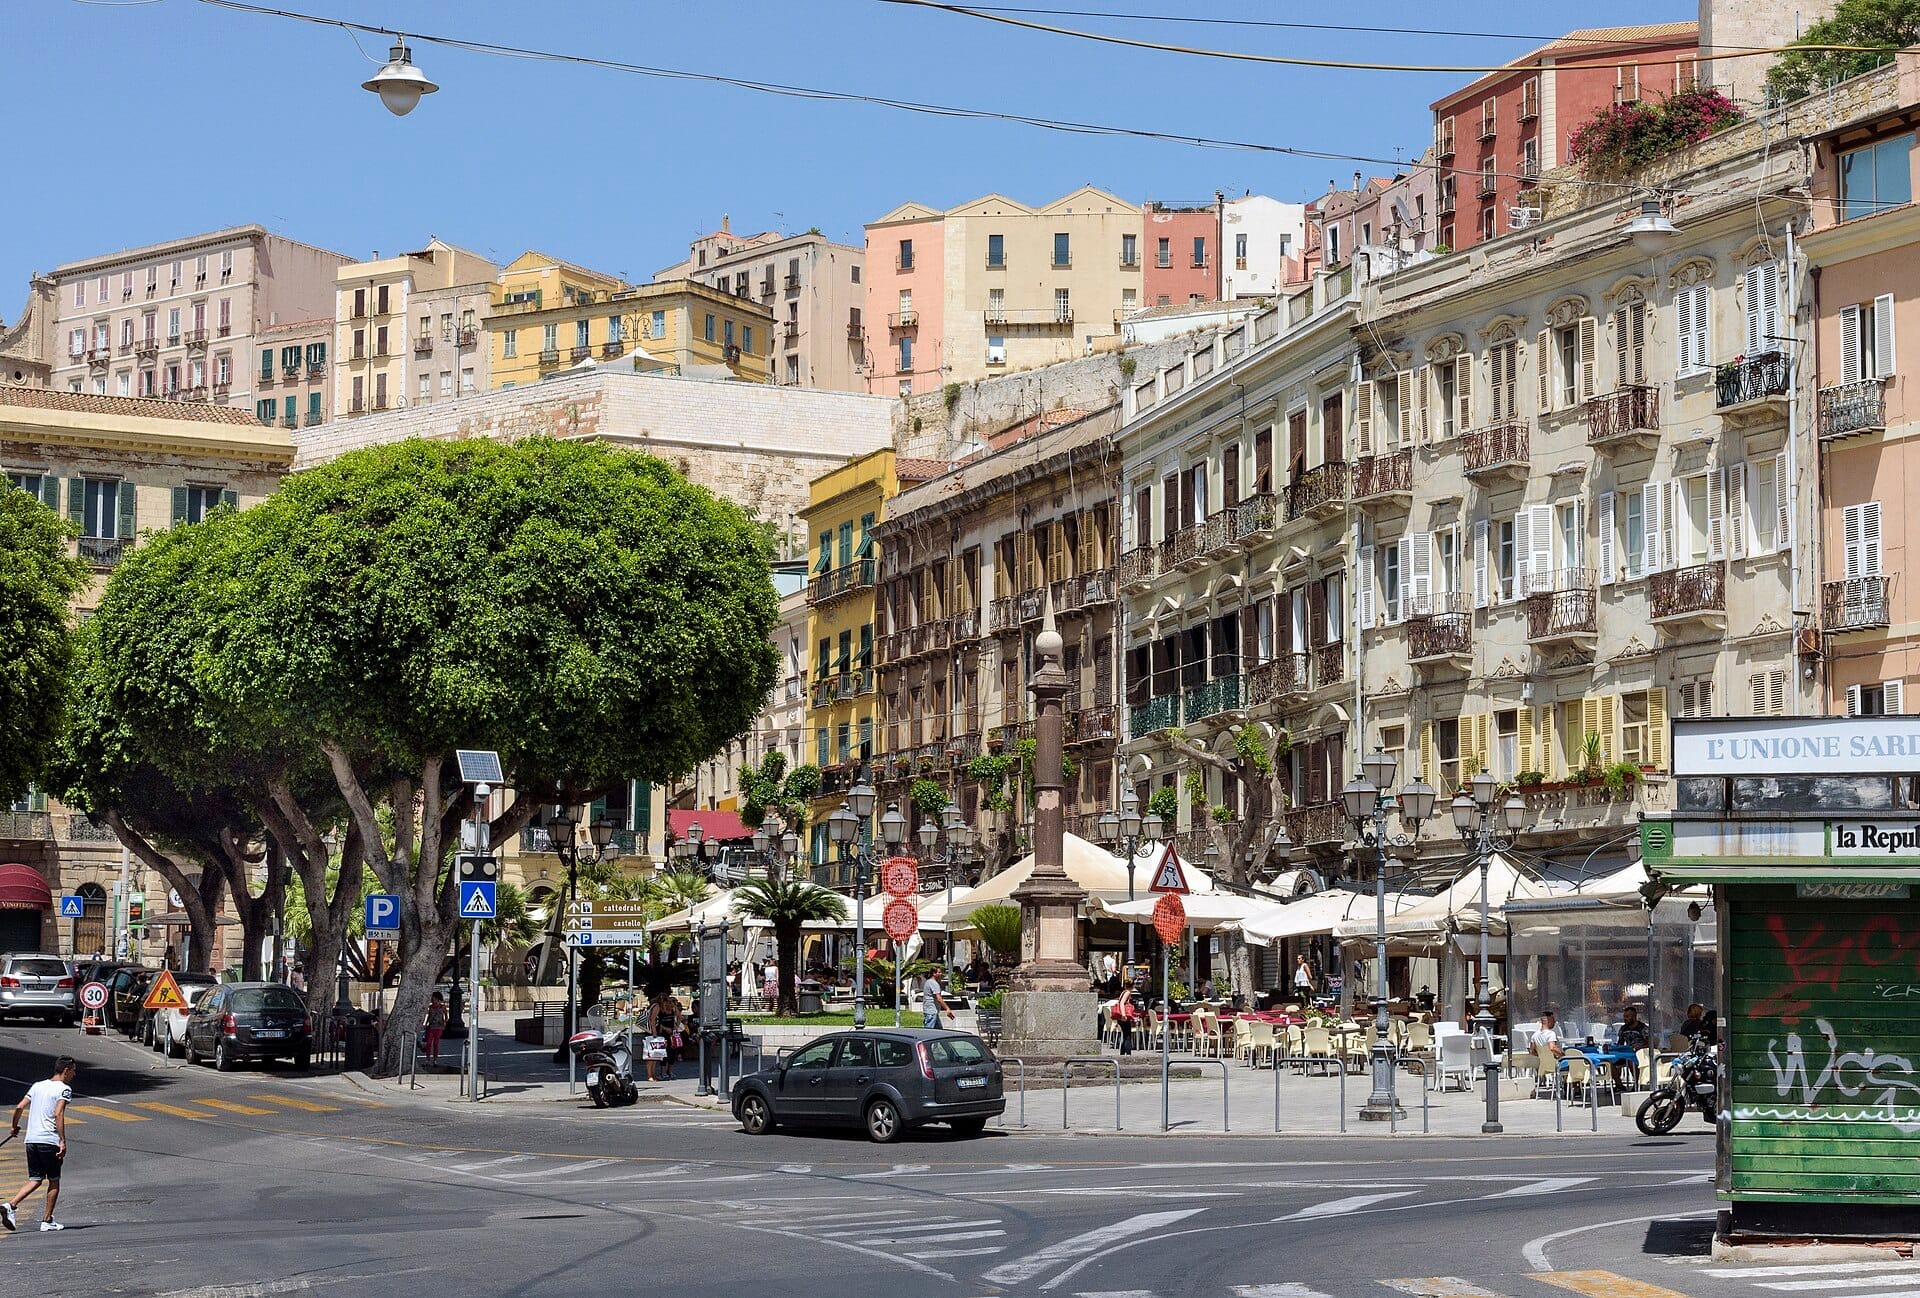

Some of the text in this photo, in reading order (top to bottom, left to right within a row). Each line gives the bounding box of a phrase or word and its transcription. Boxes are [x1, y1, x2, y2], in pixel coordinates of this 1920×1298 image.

[1707, 736, 1840, 760] L'UNIONE
[1836, 824, 1857, 848] la
[372, 898, 394, 925] P
[603, 903, 641, 912] cattedrale
[613, 919, 641, 927] castello
[87, 989, 102, 1001] 30
